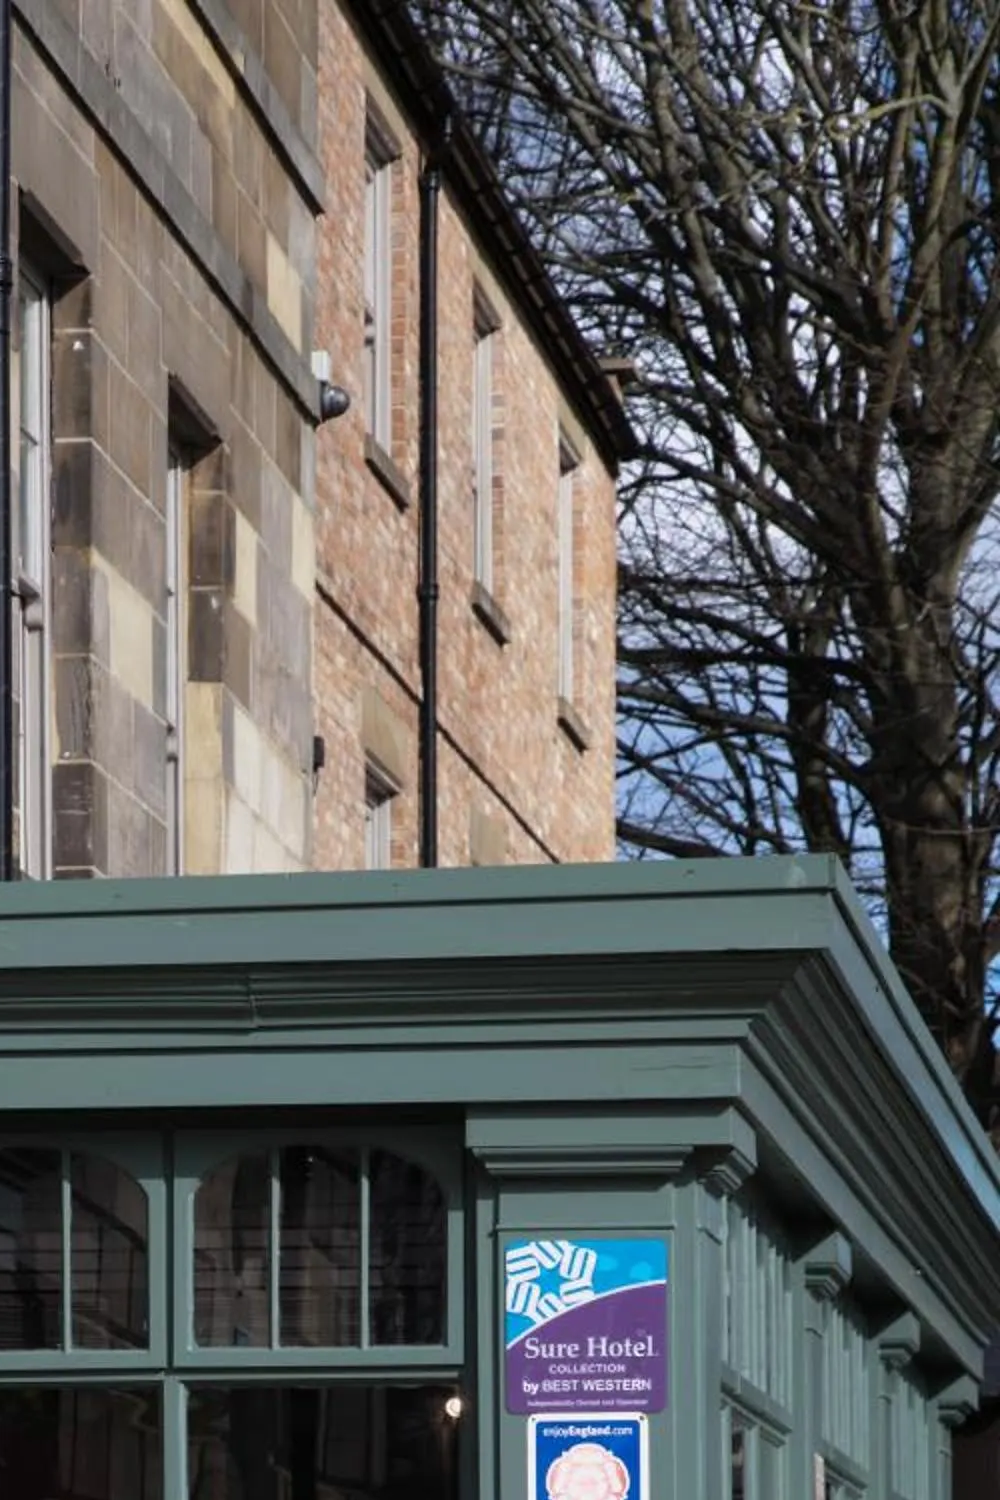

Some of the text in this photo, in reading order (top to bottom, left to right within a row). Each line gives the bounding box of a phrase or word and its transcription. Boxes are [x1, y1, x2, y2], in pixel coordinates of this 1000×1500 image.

[524, 1335, 656, 1359] Sure Hotel
[548, 1363, 626, 1374] COLLECTION
[522, 1379, 652, 1395] by BEST WESTERN
[543, 1425, 633, 1438] enjoyEngland.com
